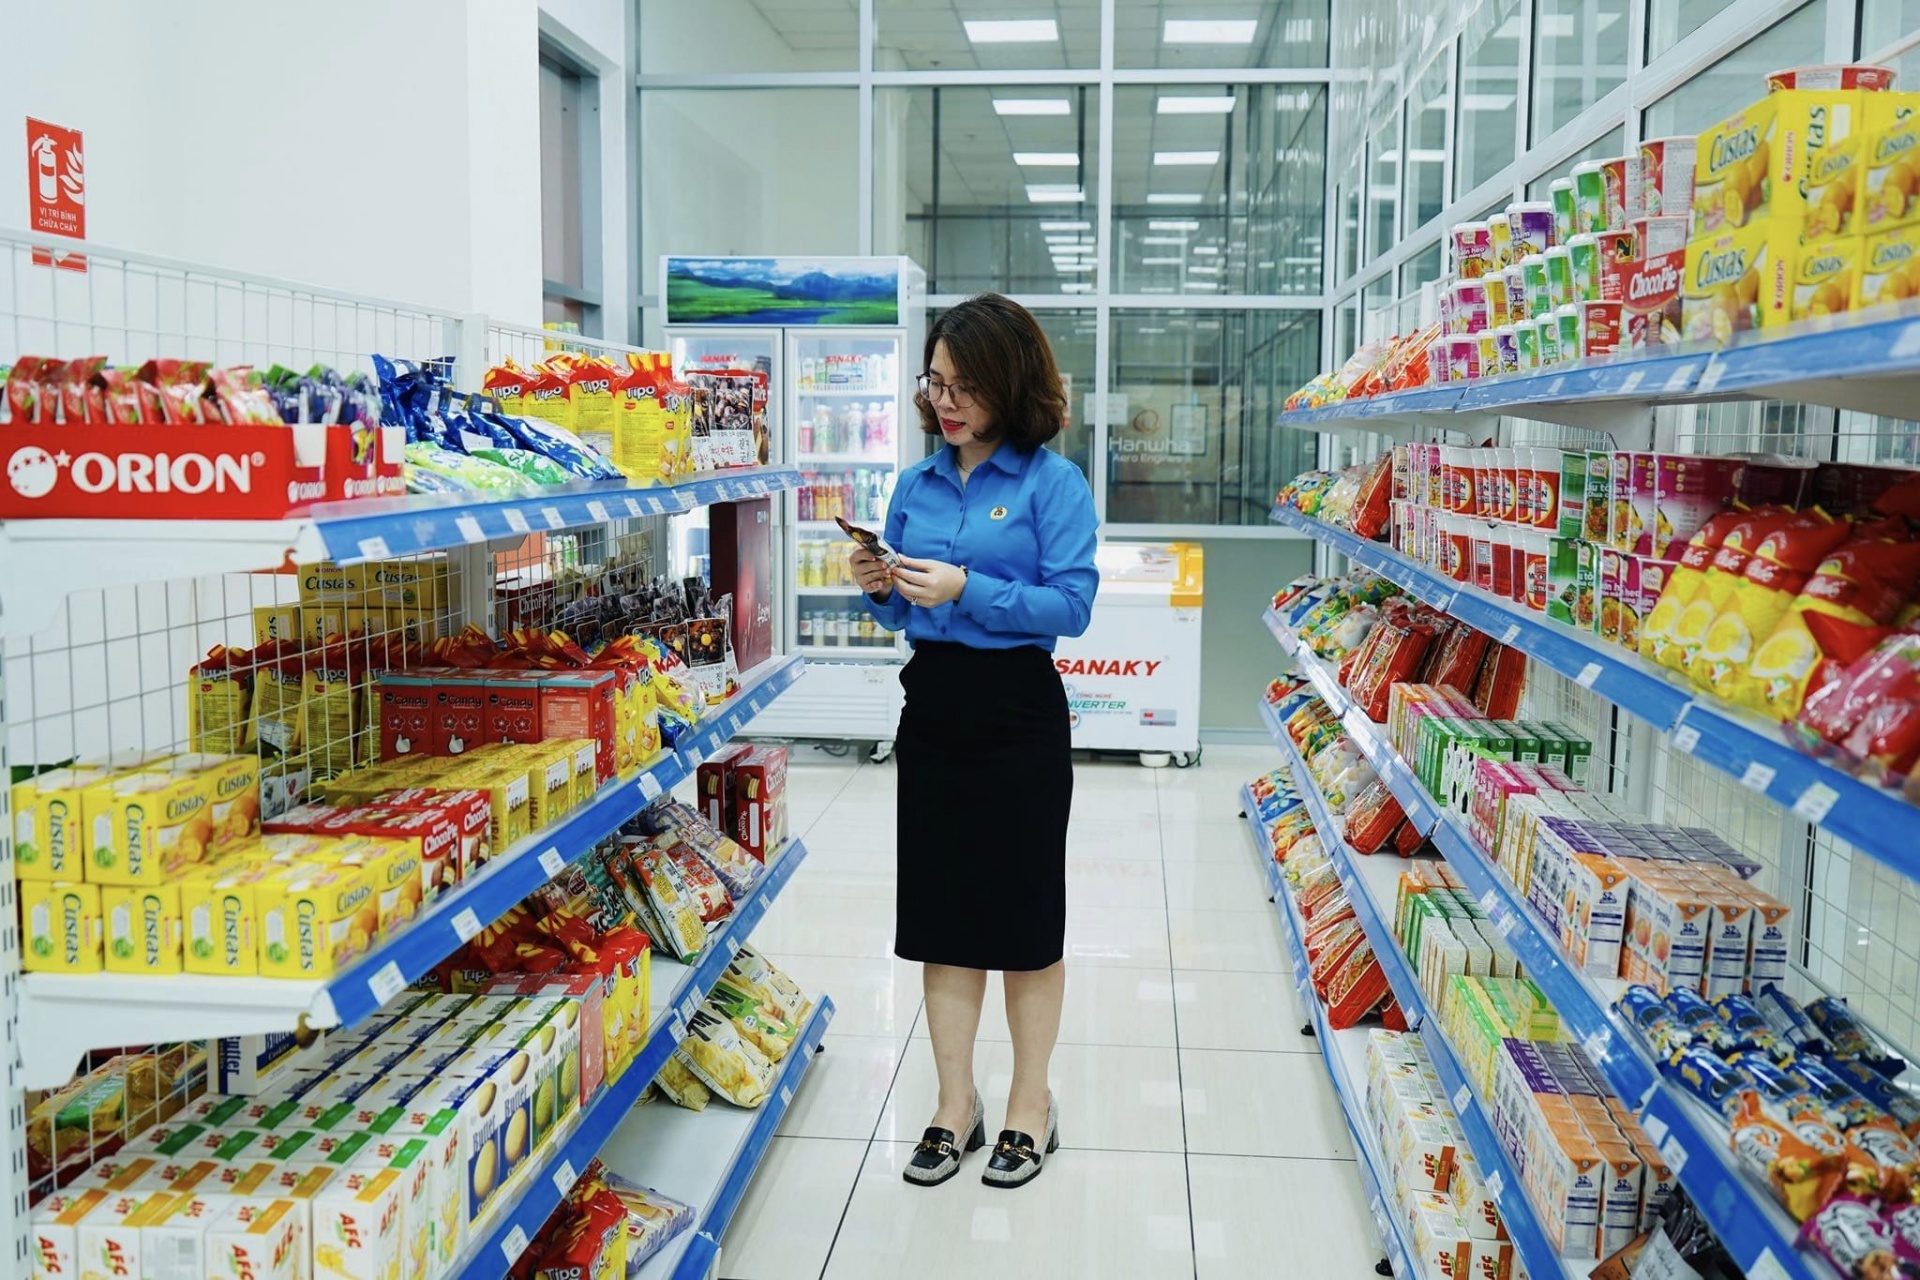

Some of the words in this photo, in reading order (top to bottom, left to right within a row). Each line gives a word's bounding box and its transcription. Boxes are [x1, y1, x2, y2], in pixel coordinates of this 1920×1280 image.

[1709, 125, 1758, 174] Custas
[38, 217, 59, 230] CHỮA
[39, 207, 47, 219] VỊ
[48, 207, 60, 219] TRÍ
[60, 209, 77, 222] BÌNH
[1697, 249, 1746, 288] Custas
[490, 383, 522, 400] Tipo
[534, 385, 563, 400] Tipo
[579, 379, 609, 396] Tipo
[625, 385, 656, 399] Tipo
[1108, 437, 1190, 452] Hanwha
[71, 451, 251, 493] ORION
[305, 576, 355, 591] Custas
[374, 570, 421, 584] Custas
[313, 667, 348, 682] Tipo
[1055, 659, 1162, 676] SANAKY
[1067, 700, 1127, 709] NVERTER
[216, 771, 253, 797] Custas
[166, 791, 207, 819] Custas
[49, 799, 70, 872] Custas
[124, 803, 144, 876] Custas
[423, 824, 458, 856] ChocoPie
[387, 857, 418, 884] Custas
[336, 883, 373, 914] Custas
[62, 893, 82, 966] Custas
[142, 894, 162, 968] Custas
[222, 894, 241, 968] Custas
[297, 898, 316, 972] Custas
[413, 973, 438, 988] ipo
[504, 1083, 528, 1118] Butter
[473, 1114, 496, 1149] Butter
[1424, 1152, 1436, 1179] AFC
[1485, 1200, 1497, 1227] AFC
[339, 1212, 362, 1249] AFC
[38, 1236, 62, 1274] AFC
[105, 1238, 129, 1276] AFC
[232, 1244, 254, 1280] AFC
[1439, 1251, 1452, 1277] AFC
[1482, 1255, 1494, 1280] AFC
